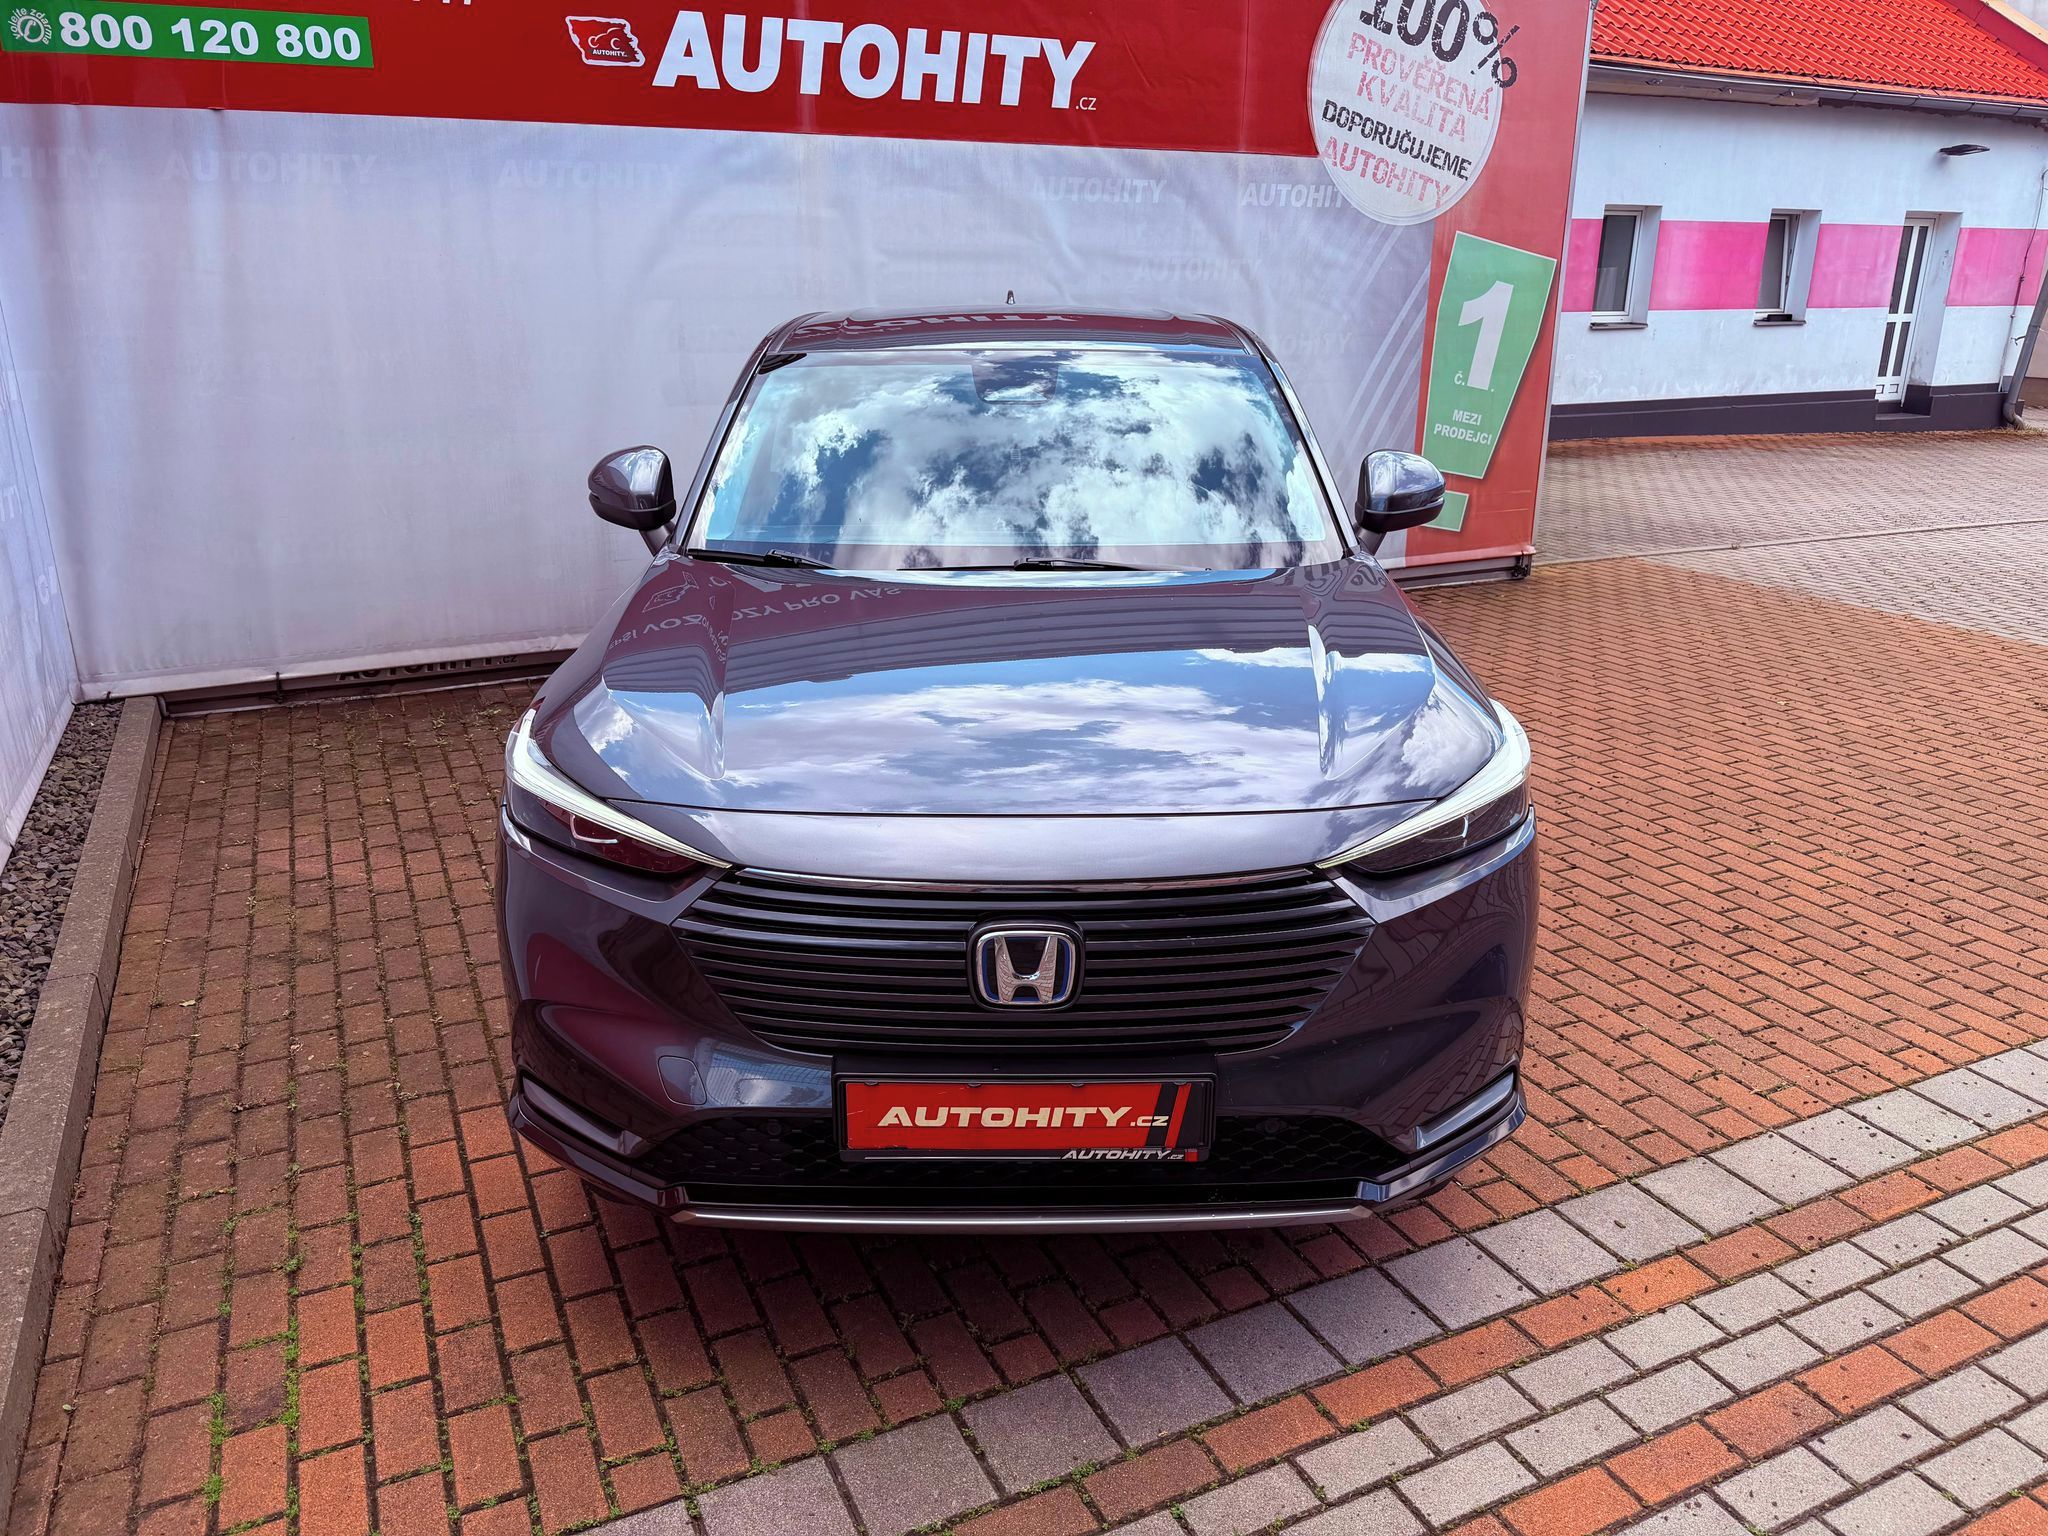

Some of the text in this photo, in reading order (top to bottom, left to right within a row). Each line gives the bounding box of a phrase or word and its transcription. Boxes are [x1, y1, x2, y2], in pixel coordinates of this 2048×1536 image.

[8, 7, 52, 45] volejte zdarma
[58, 11, 362, 61] 800 120 800
[1347, 32, 1493, 121] PROVĚŘENÁ
[1356, 70, 1466, 142] KVALITA
[1321, 99, 1472, 181] DOPORUČUJEME
[160, 151, 378, 185] AUTOHITY
[497, 158, 681, 191] AUTOHITY
[1320, 136, 1451, 209] AUTOHITY
[1032, 175, 1168, 204] AUTOHITY
[1241, 182, 1353, 208] AUTOHIT
[1433, 423, 1493, 446] PRODEJCI
[1452, 408, 1482, 426] MEZI
